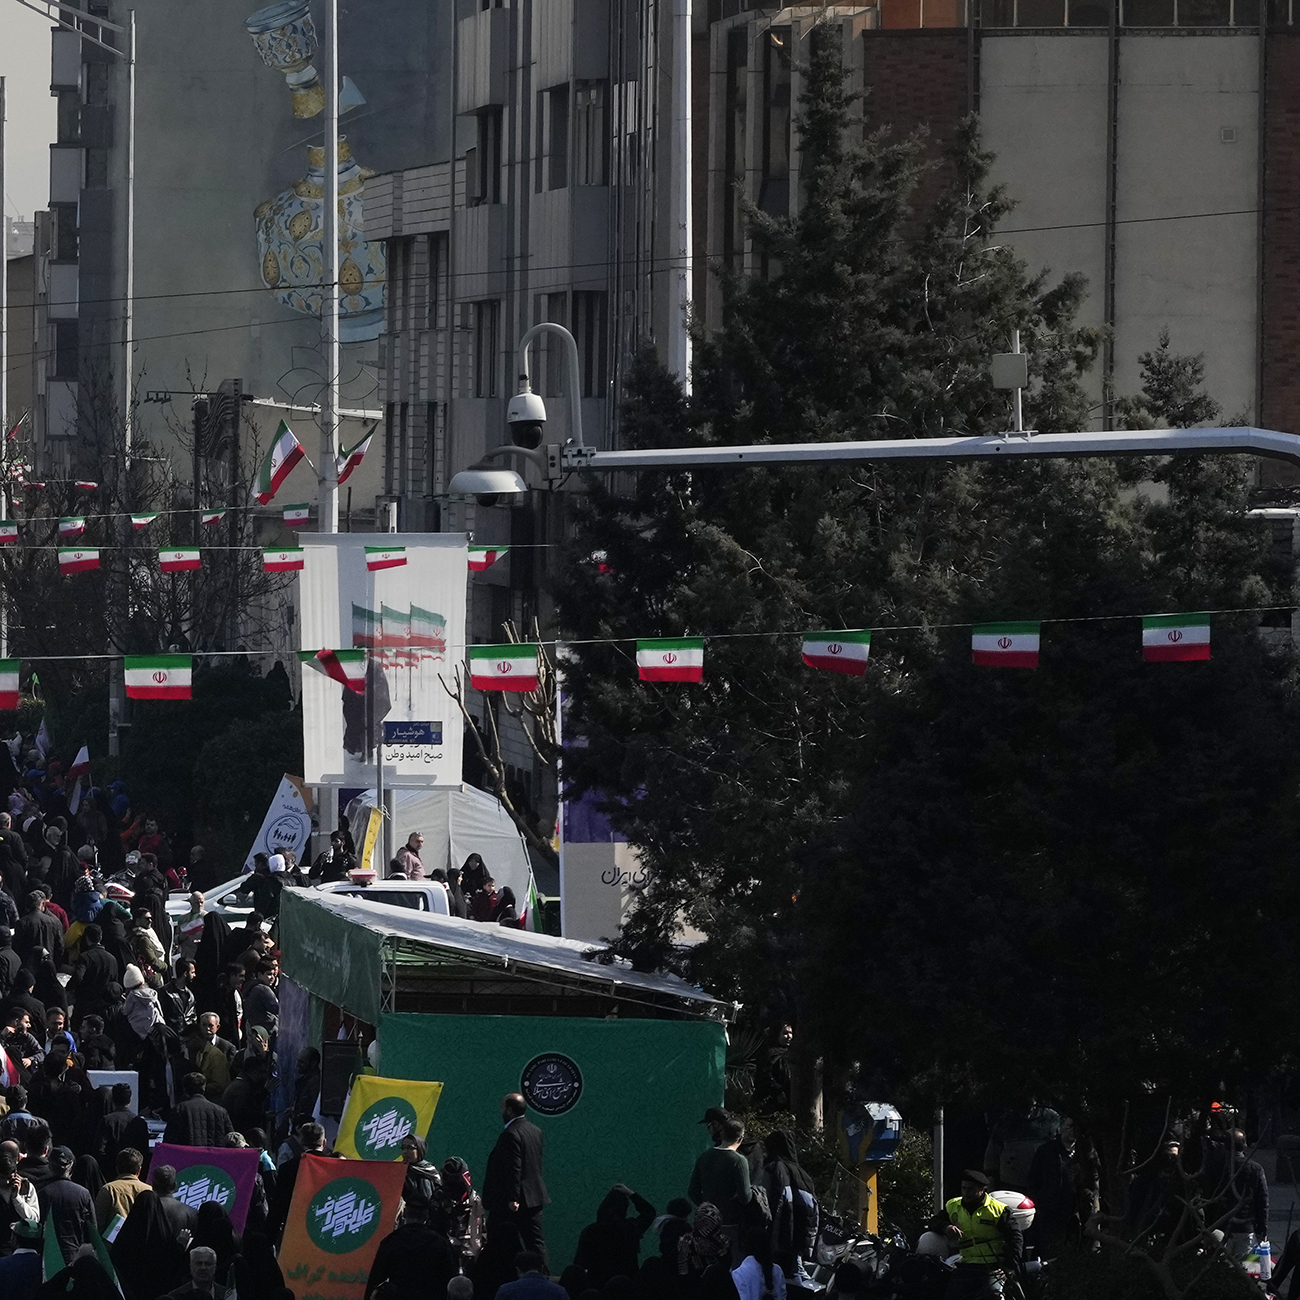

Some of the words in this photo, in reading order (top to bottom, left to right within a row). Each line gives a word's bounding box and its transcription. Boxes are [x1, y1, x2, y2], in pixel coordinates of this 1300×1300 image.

[391, 726, 425, 739] هوشیار
[385, 749, 405, 761] وطن
[405, 749, 423, 761] امید
[423, 752, 444, 763] صبح
[601, 866, 632, 887] ایران
[823, 1223, 844, 1238] POLICE
